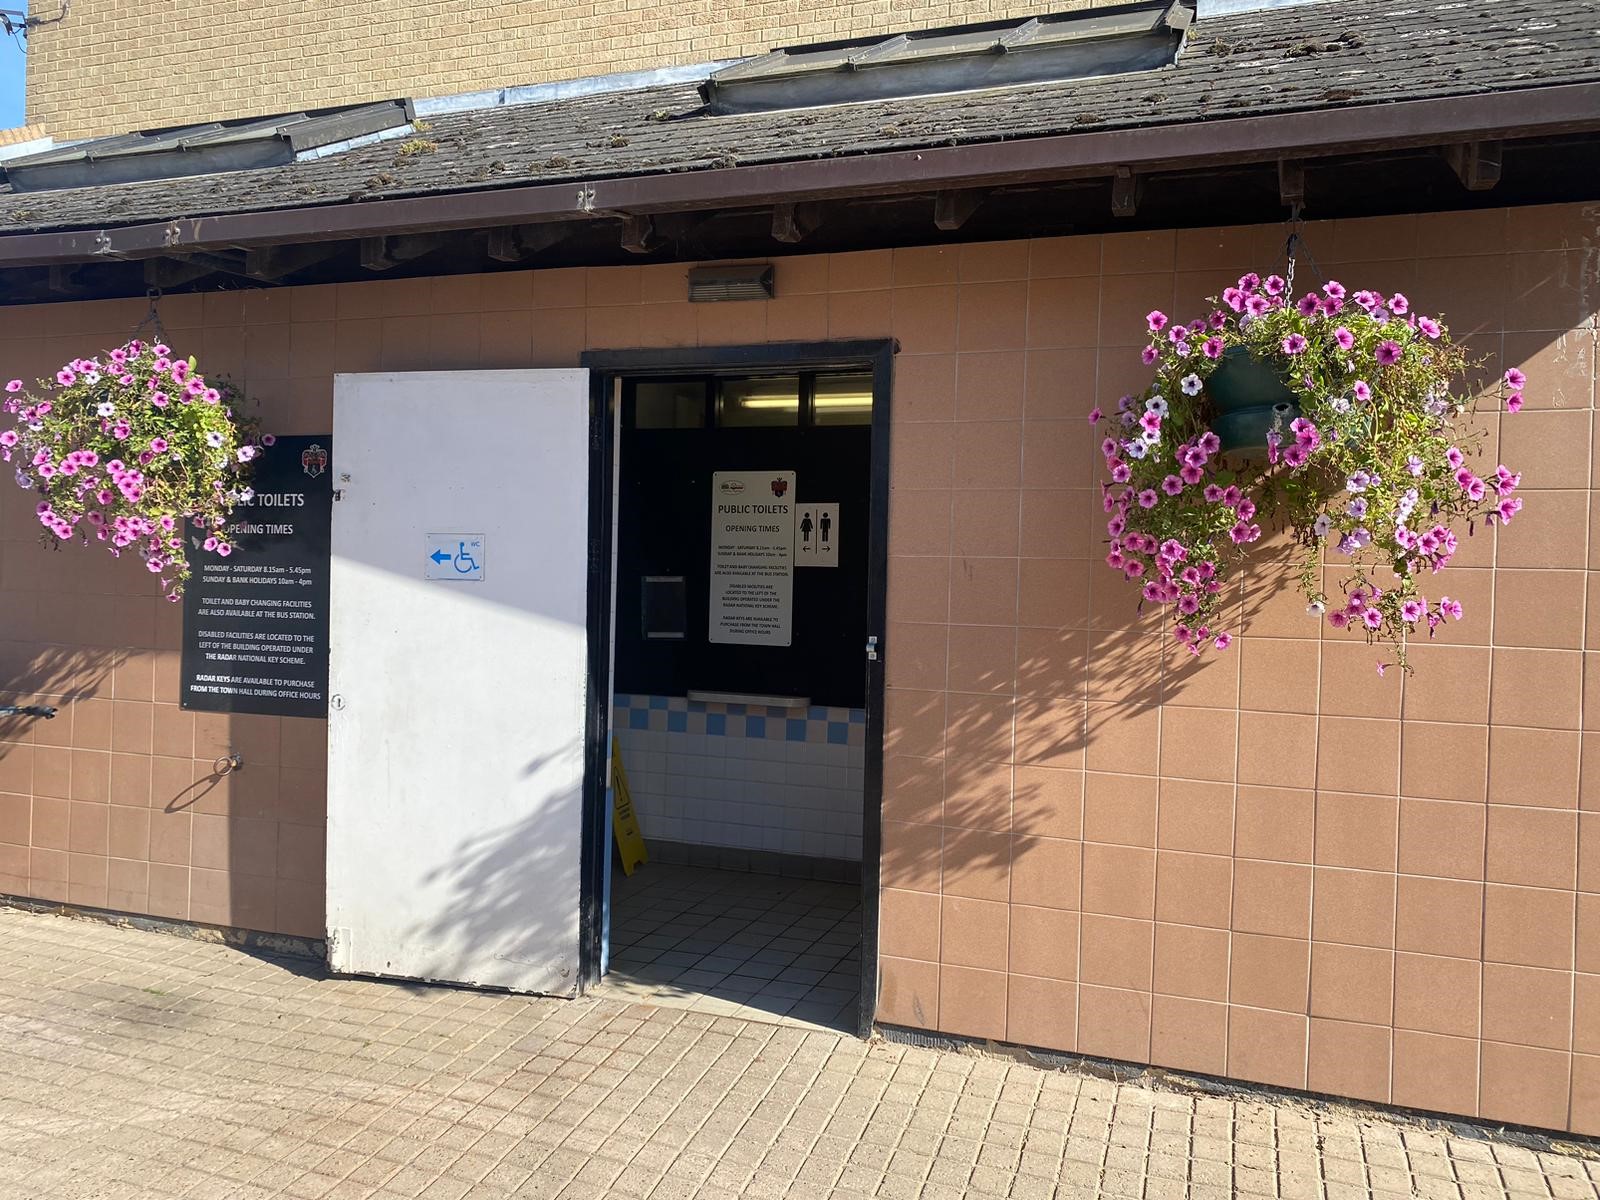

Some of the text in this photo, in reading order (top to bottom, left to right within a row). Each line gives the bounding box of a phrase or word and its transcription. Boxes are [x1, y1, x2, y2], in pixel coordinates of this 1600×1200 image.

[257, 493, 304, 507] TOILETS
[718, 504, 789, 514] PUBLIC TOILETS
[265, 524, 294, 535] TIMES
[725, 524, 780, 533] OPENING TIMES
[233, 565, 263, 573] SATURDAY
[263, 566, 285, 574] 8.15am
[289, 567, 312, 576] 5.45pm
[249, 577, 278, 585] HOLIDAYS
[298, 578, 313, 587] 4pm
[201, 597, 221, 605] TOILET
[221, 598, 234, 606] AND
[250, 599, 282, 607] CHANGING
[282, 600, 312, 608] FACILITIES
[225, 609, 255, 618] AVAILABLE
[256, 610, 263, 618] AT
[276, 611, 289, 619] BUS
[289, 611, 316, 620] STATION.
[198, 630, 225, 638] DISABLED
[225, 631, 254, 639] FACILITIES
[266, 633, 293, 641] LOCATED
[293, 634, 302, 642] TO
[199, 641, 212, 649] LEFT
[221, 642, 232, 650] THE
[232, 643, 260, 651] BUILDING
[261, 644, 292, 653] OPERATED
[292, 646, 314, 654] UNDER
[205, 652, 217, 660] THE
[217, 653, 238, 661] RADAR
[238, 654, 267, 663] NATIONAL
[279, 656, 306, 665] SCHEME.
[196, 674, 216, 682] RADAR
[216, 675, 231, 683] KEYS
[230, 676, 243, 684] ARE
[242, 677, 274, 686] AVAILABLE
[283, 679, 315, 688] PURCHASE
[190, 685, 208, 693] FROM
[208, 686, 220, 694] THE
[254, 688, 278, 697] DURING
[278, 690, 299, 698] OFFICE
[299, 692, 321, 700] HOURS
